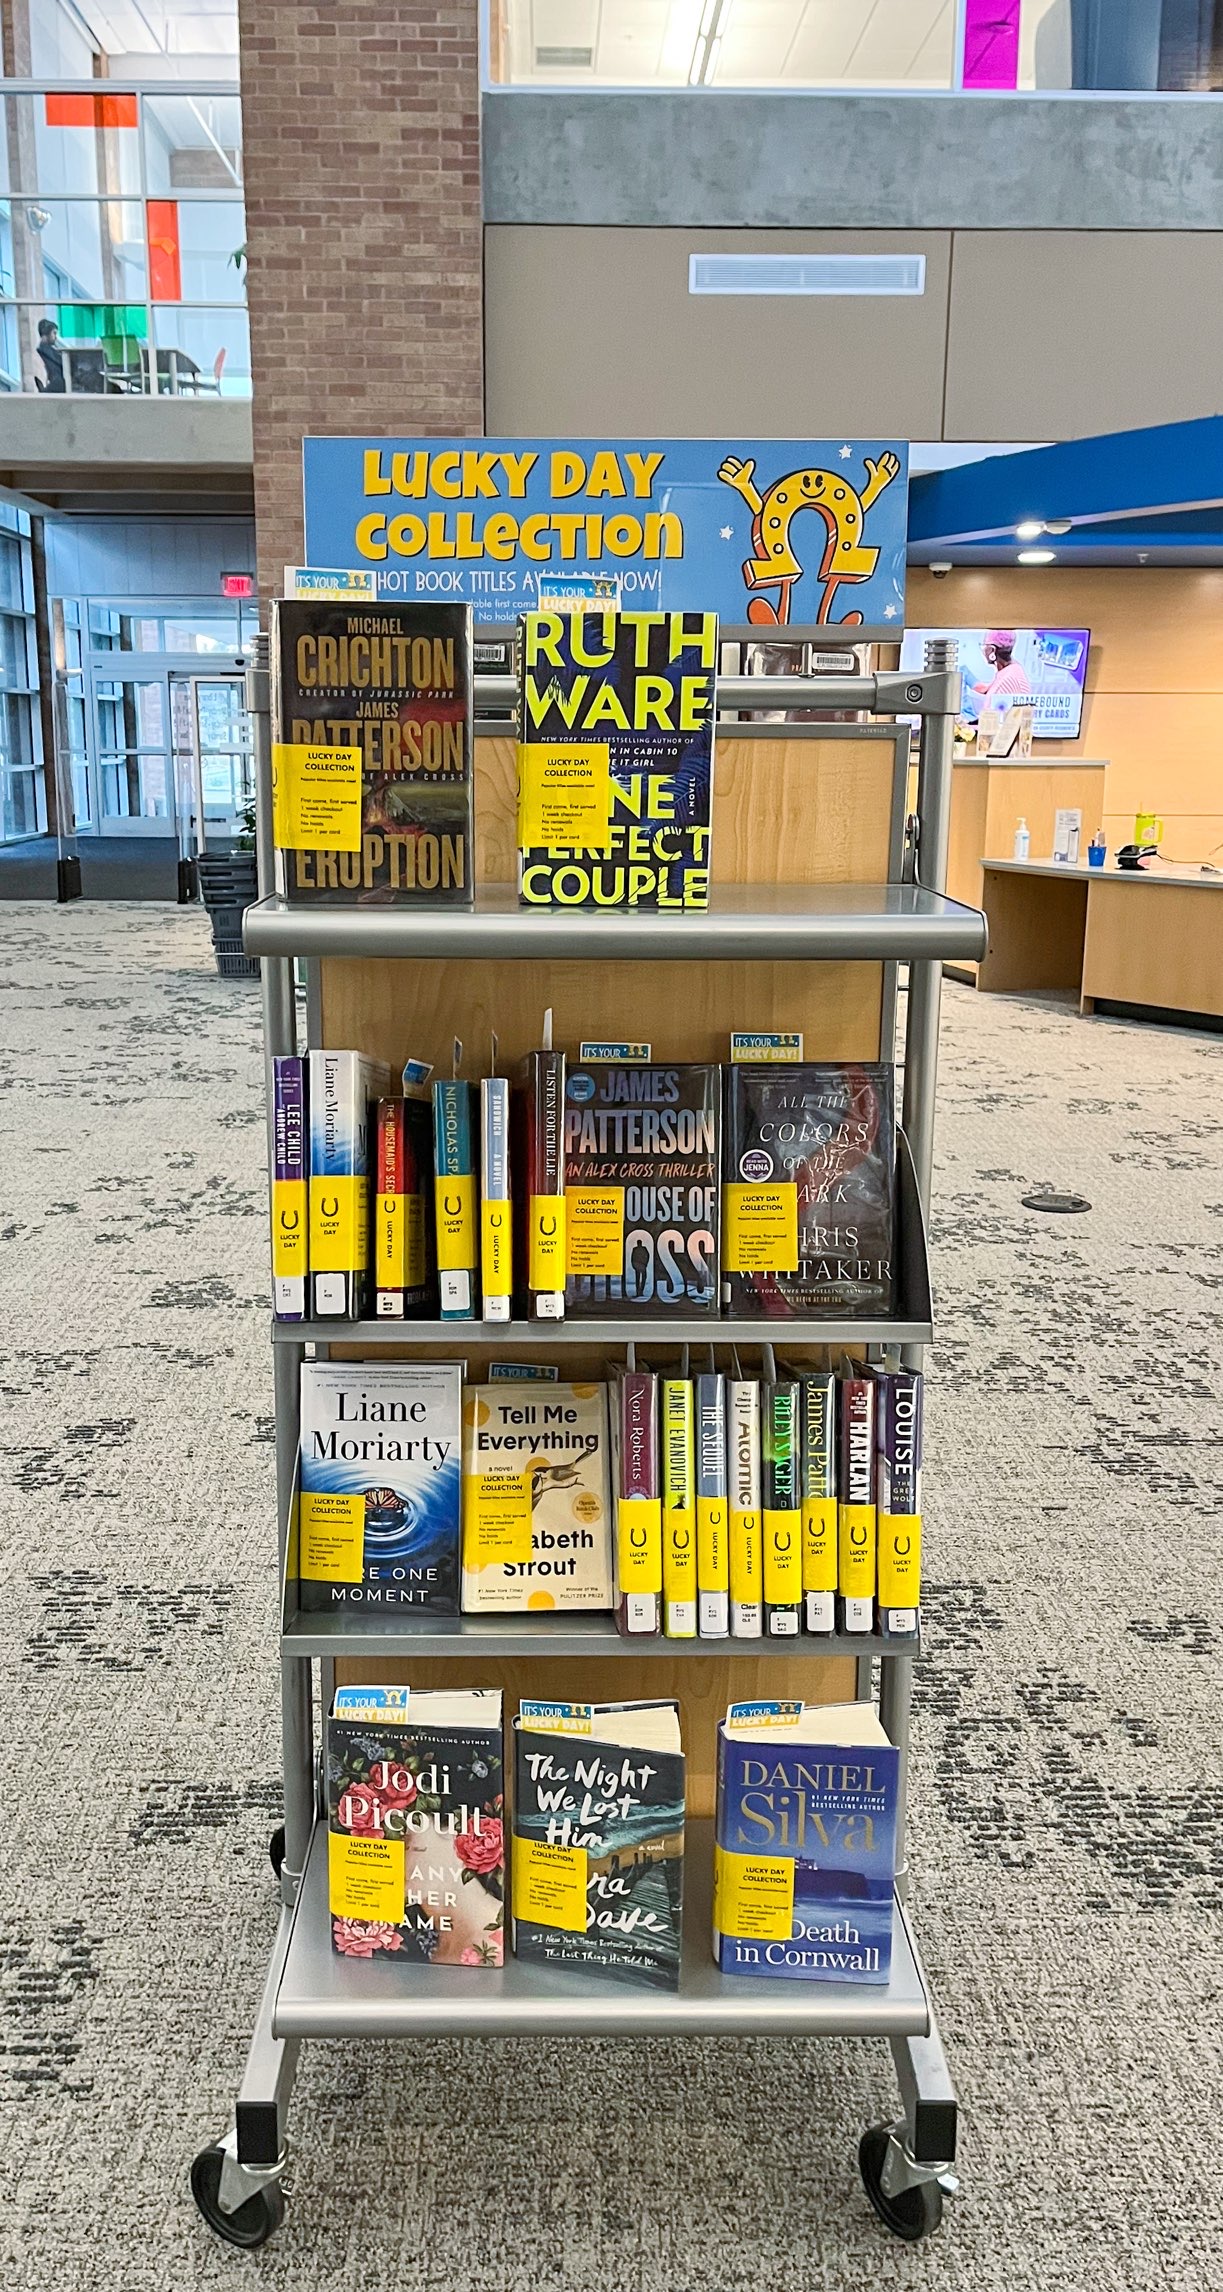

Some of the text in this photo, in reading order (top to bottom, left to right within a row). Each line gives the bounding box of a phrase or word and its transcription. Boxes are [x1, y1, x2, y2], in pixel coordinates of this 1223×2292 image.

[363, 449, 665, 499] LUCKY DAY
[296, 574, 339, 590] IT'S YOUR
[378, 571, 409, 593] HOT
[416, 571, 464, 593] BOOK
[469, 570, 516, 592] TITLES
[614, 569, 662, 592] NOW!
[543, 586, 586, 598] IT'S YOUR
[479, 612, 492, 620] No
[543, 599, 582, 613] LUCKY
[348, 617, 403, 634] MICHAEL
[525, 612, 715, 669] RUTH
[297, 635, 454, 689] CRICHTON
[299, 689, 345, 697] CREATOR
[369, 689, 422, 698] JURASSIC
[427, 690, 454, 699] PARK
[526, 675, 713, 731] WARE
[1013, 697, 1071, 707] HOMEBOUND
[356, 701, 399, 718] JAMES
[1045, 709, 1069, 718] CARDS
[305, 763, 355, 771] COLLECTION
[608, 774, 675, 819] NE
[297, 834, 464, 889] ERUPTION
[522, 865, 710, 908] COUPLE
[599, 1070, 679, 1103] JAMES
[287, 1105, 300, 1125] LEE
[322, 1058, 338, 1160] Liane Moriarty
[778, 1096, 808, 1108] ALL
[446, 1086, 458, 1154] NICHOLAS
[546, 1070, 556, 1176] LISTEN FOR THE LIE
[565, 1109, 716, 1154] PATTERSON
[760, 1123, 870, 1142] COLORS
[277, 1109, 286, 1164] ANDREW CHILD
[287, 1131, 300, 1165] CHILD
[493, 1095, 501, 1186] SANDWICH NOVEL
[565, 1162, 716, 1178] AN ALEX CROSS THRILLER
[625, 1186, 716, 1222] OUSE OF
[797, 1185, 851, 1203] ARK
[798, 1226, 859, 1247] HRIS
[335, 1392, 426, 1423] Liane
[498, 1406, 577, 1424] Tell Me
[807, 1381, 829, 1445] James
[477, 1431, 599, 1454] Everything
[629, 1386, 645, 1480] Nora Roberts
[669, 1388, 686, 1491] JANET EVANOVICH
[702, 1405, 724, 1478] THE SEQUEL
[895, 1389, 915, 1475] LOUISE
[311, 1431, 451, 1471] Moriarty
[738, 1422, 752, 1505] Atomic
[850, 1422, 870, 1500] HARLAN
[532, 1529, 594, 1549] abeth
[393, 1568, 438, 1581] ONE
[503, 1558, 577, 1576] Strout
[332, 1588, 429, 1603] MOMENT
[339, 1697, 377, 1708] IT'S YOUR
[339, 1708, 374, 1721] LUCKY
[410, 1735, 458, 1744] BESTSELLING
[374, 1760, 452, 1796] Jodi
[524, 1753, 658, 1798] The Night
[740, 1760, 886, 1793] DANIEL
[536, 1784, 640, 1827] We Lost
[812, 1802, 856, 1810] BESTSELLING
[863, 1796, 886, 1804] TIMES
[343, 1795, 488, 1838] Picoult
[738, 1790, 880, 1853] Silva
[545, 1818, 613, 1848] Him
[410, 1865, 463, 1882] ANY
[562, 1936, 576, 1944] York
[790, 1919, 861, 1945] Death
[582, 1952, 606, 1965] Thing
[735, 1940, 880, 1971] in Cornwall
